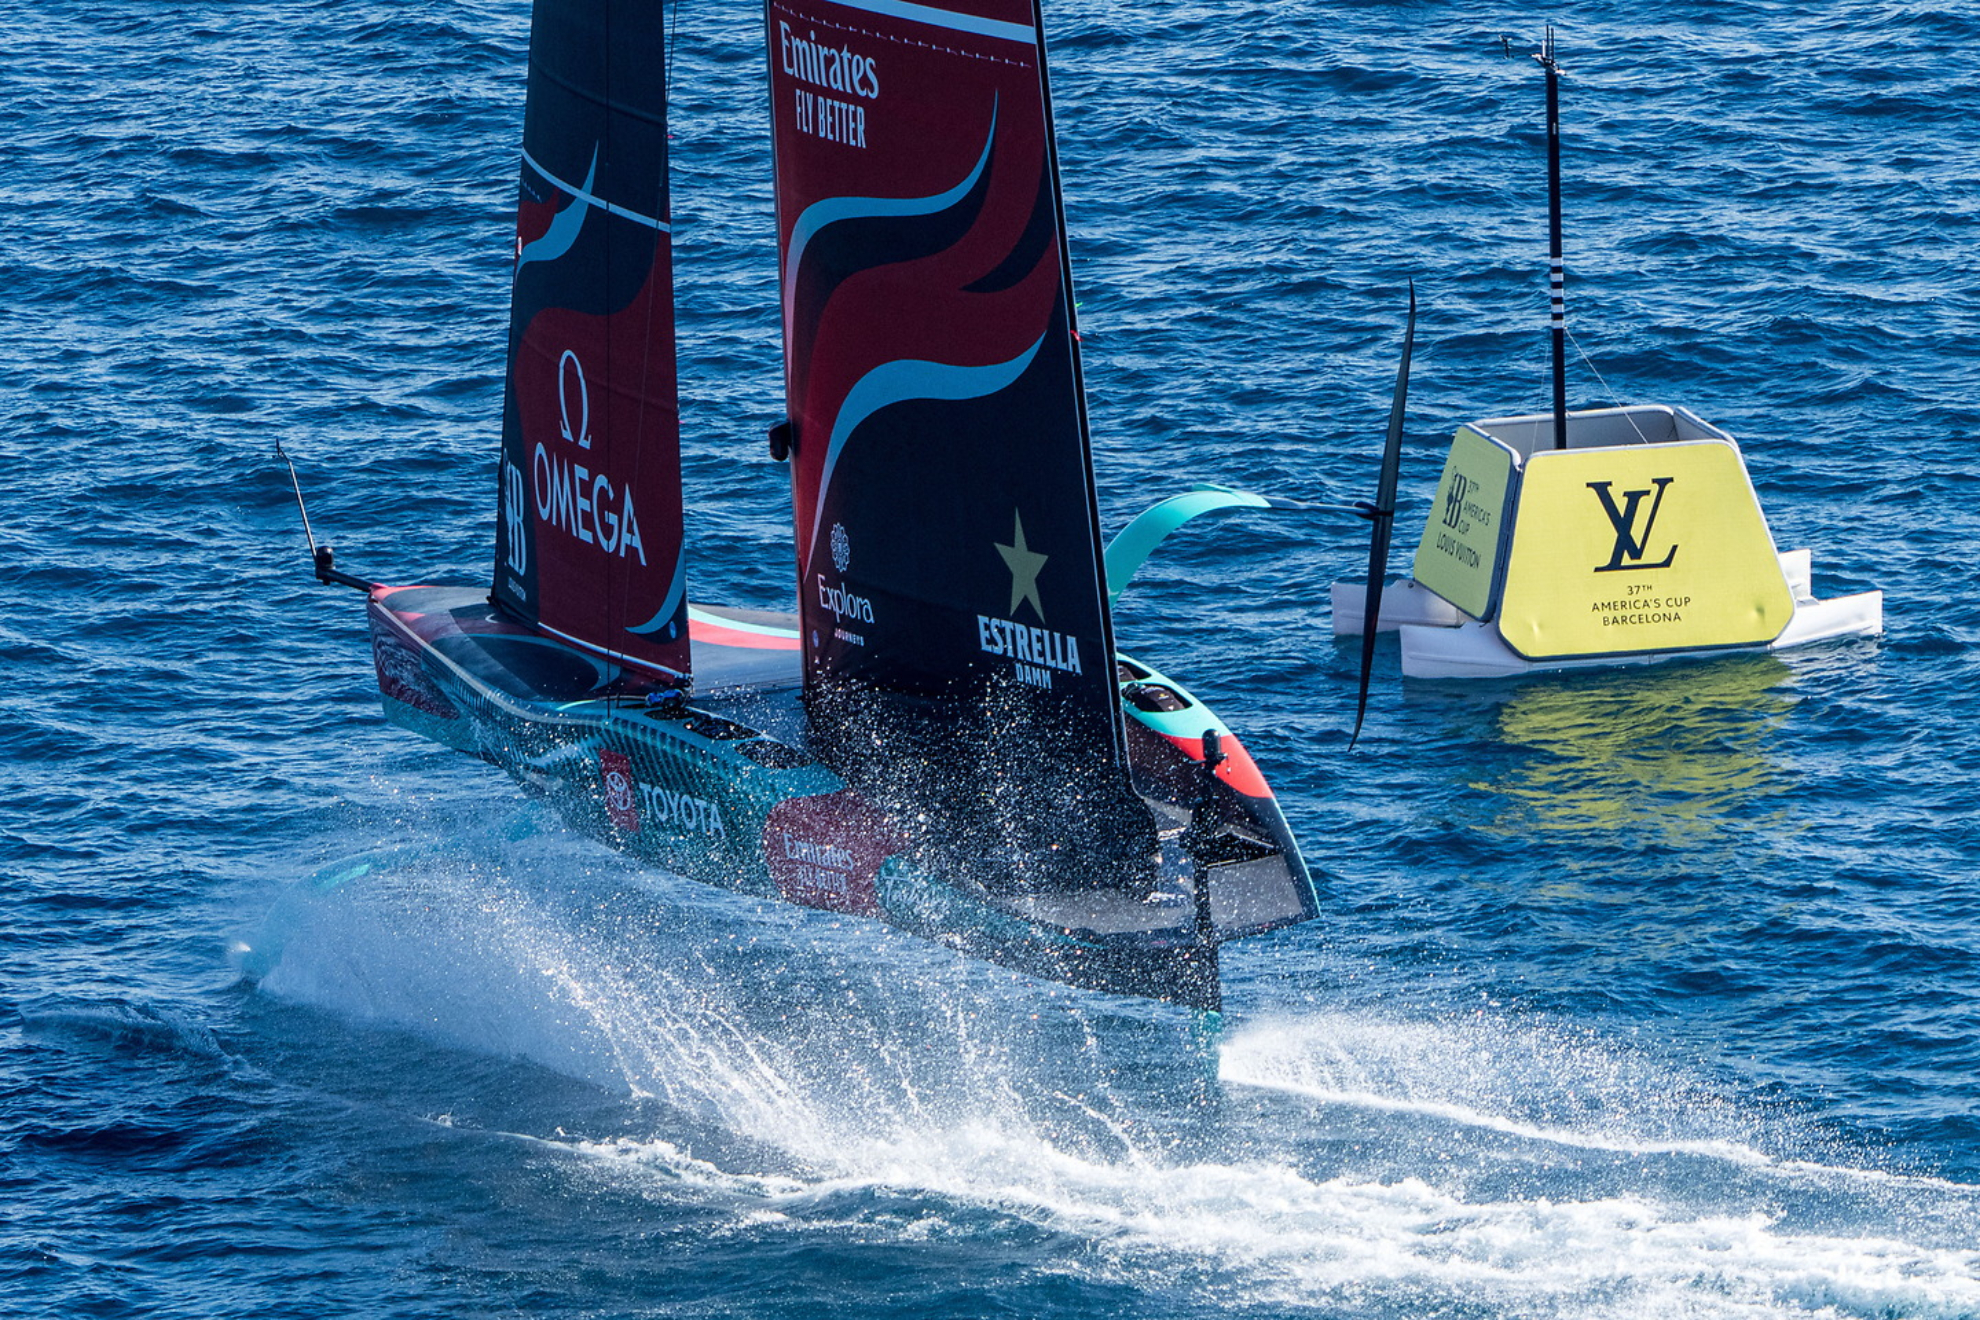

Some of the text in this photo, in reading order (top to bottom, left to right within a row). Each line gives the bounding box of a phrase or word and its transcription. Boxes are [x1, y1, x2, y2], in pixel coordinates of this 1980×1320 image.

[780, 20, 879, 99] Emirates
[796, 88, 867, 149] FLY BETTER
[534, 441, 648, 567] OMEGA
[1458, 519, 1471, 536] CUP
[1436, 531, 1482, 569] LOUIS VUITTON
[817, 573, 875, 624] Explora
[1591, 596, 1692, 613] AMERICA'S CUP
[1627, 584, 1653, 597] 37TH
[1602, 611, 1683, 627] BARCELONA
[977, 614, 1083, 676] ESTRELLA
[1014, 661, 1053, 690] DAMM
[638, 781, 726, 838] TOYOTA
[783, 832, 855, 872] Emirates
